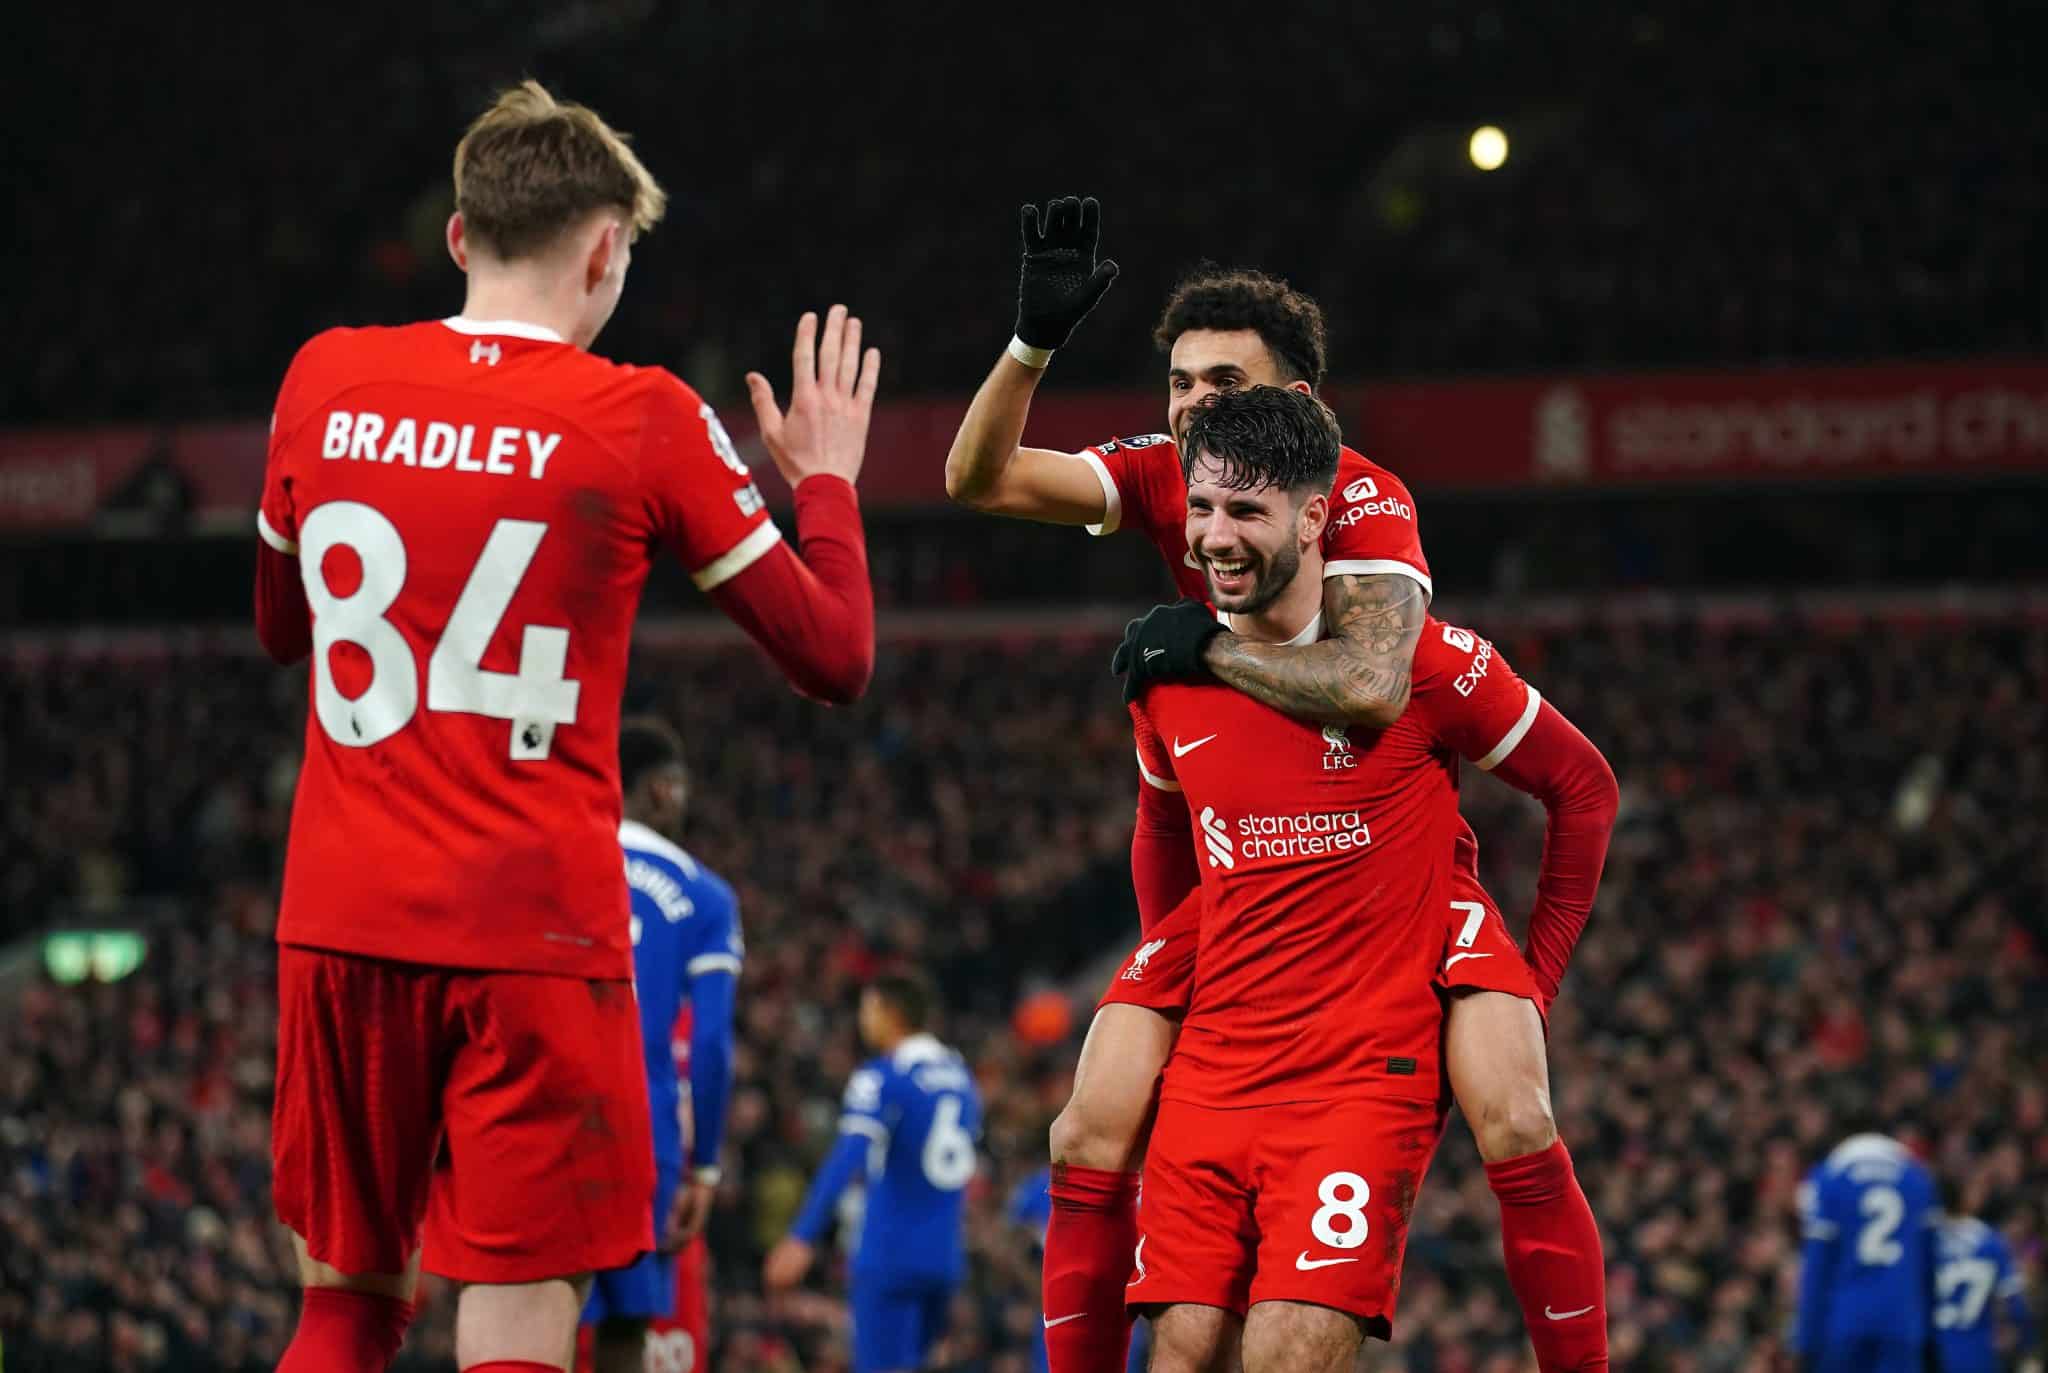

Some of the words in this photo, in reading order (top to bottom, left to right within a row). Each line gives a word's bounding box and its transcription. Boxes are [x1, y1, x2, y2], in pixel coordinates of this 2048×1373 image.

[321, 411, 561, 479] BRADLEY
[300, 501, 580, 761] 84
[1238, 810, 1361, 836] standard
[1242, 823, 1371, 858] chartered
[1449, 901, 1486, 948] 7
[921, 1093, 977, 1192] 6
[1311, 1171, 1370, 1249] 8
[1858, 1184, 1905, 1267] 2
